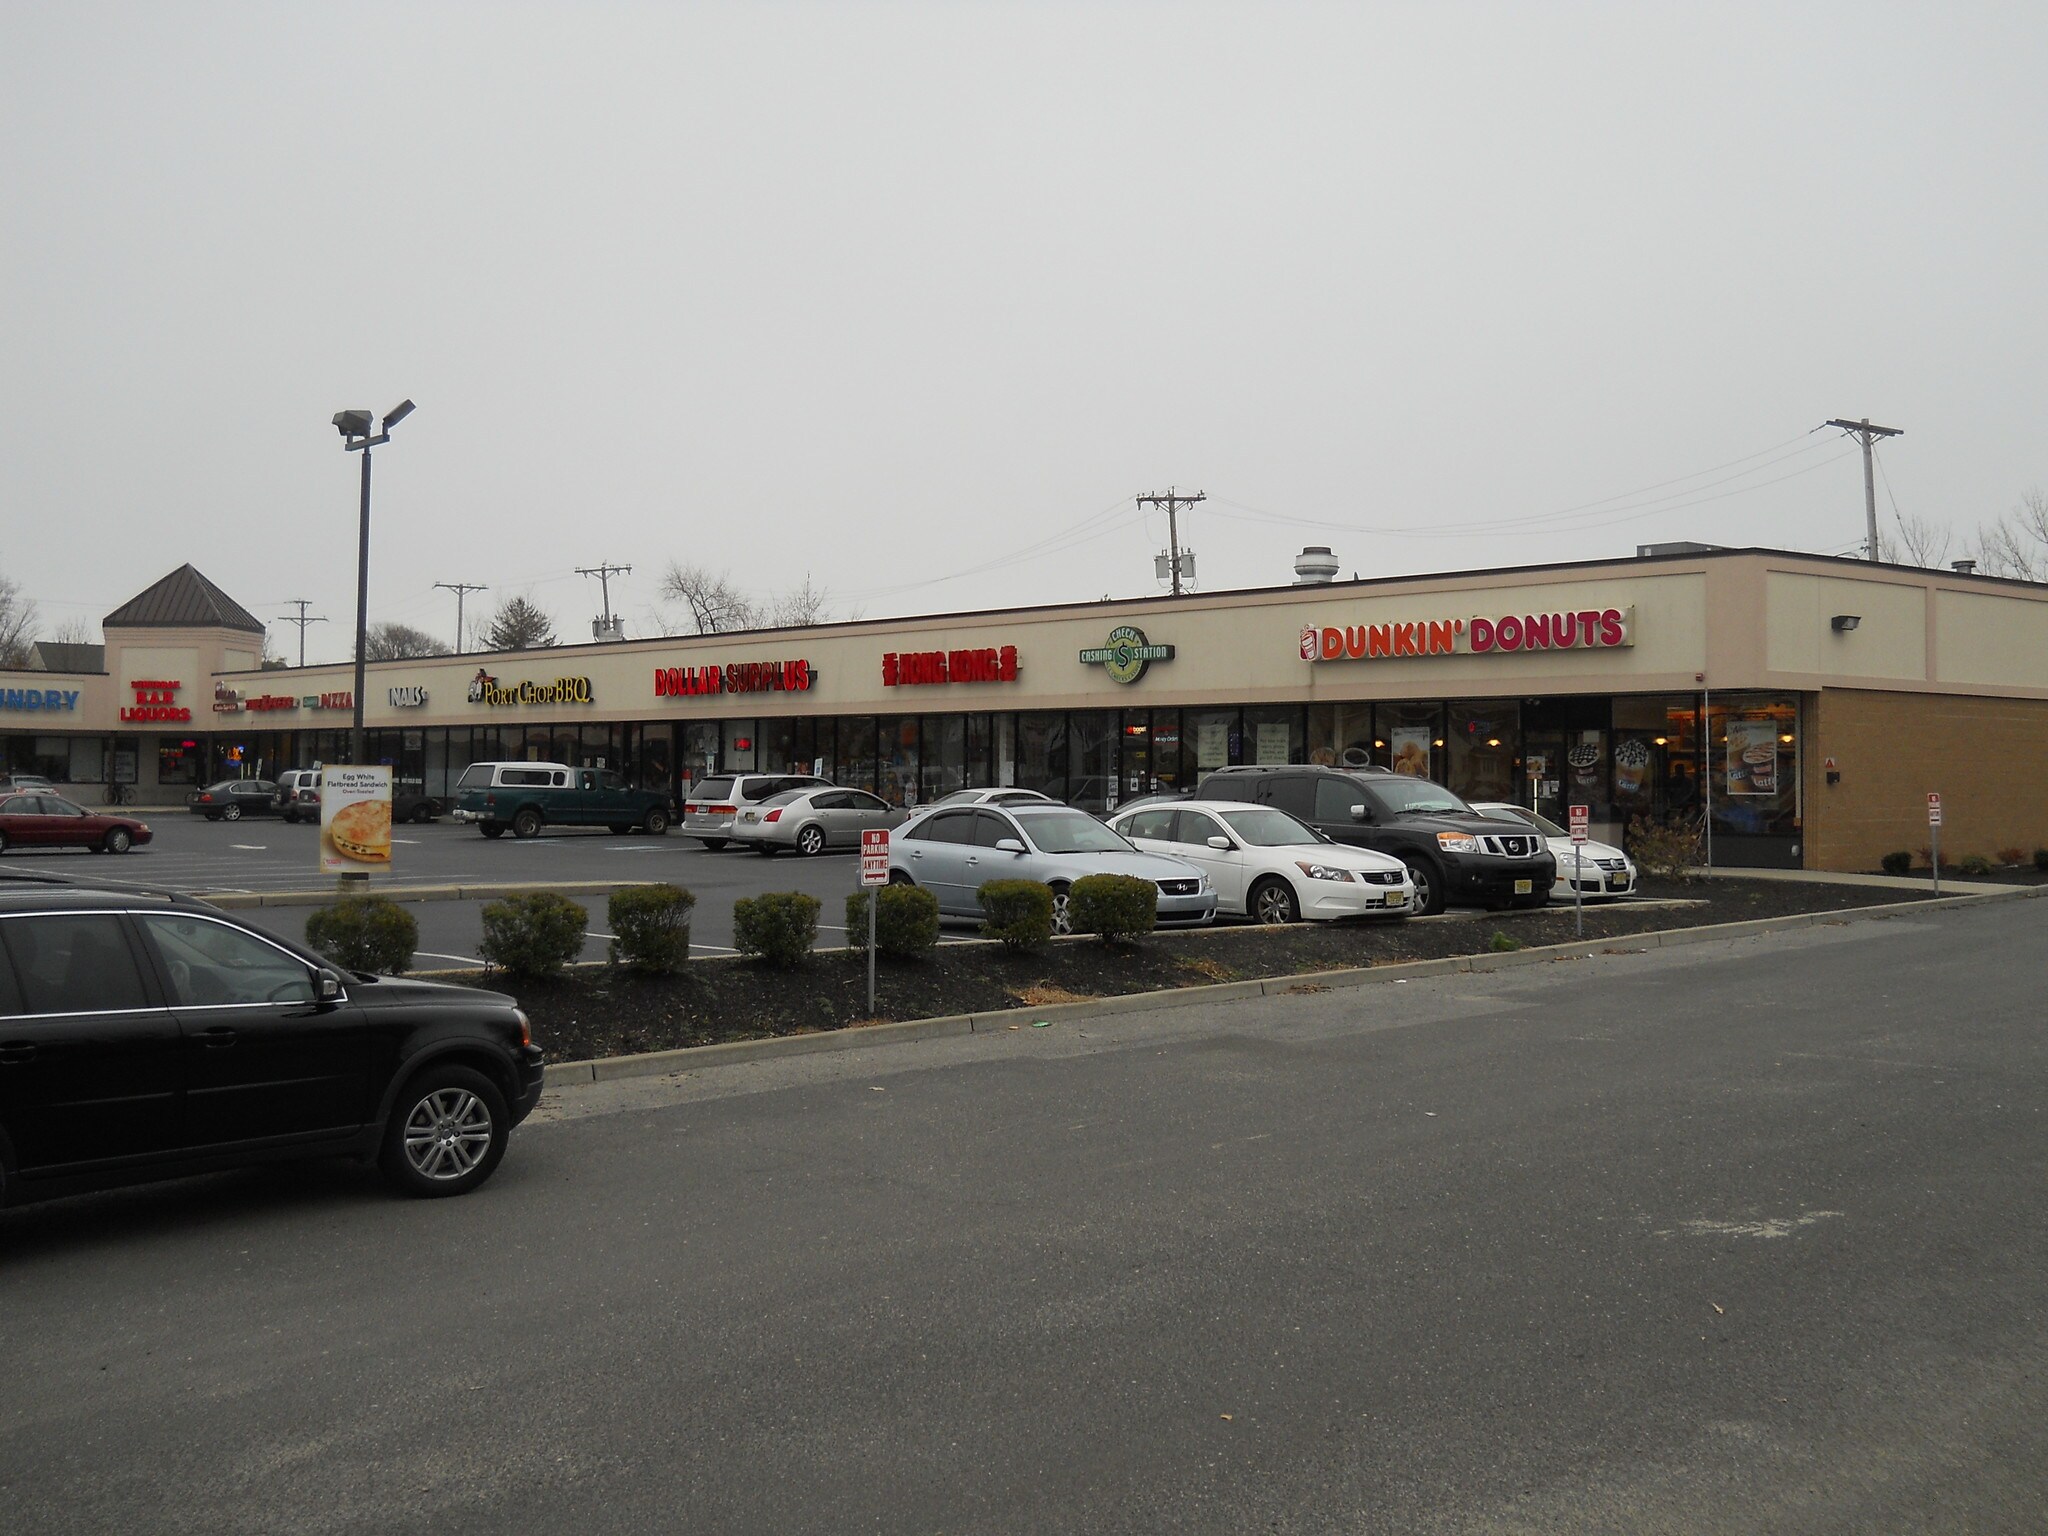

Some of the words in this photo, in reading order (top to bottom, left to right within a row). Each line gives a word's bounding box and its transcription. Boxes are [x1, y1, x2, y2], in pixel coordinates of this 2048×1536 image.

[1111, 627, 1135, 641] CHECK
[1322, 619, 1463, 660] DUNKIN'
[1470, 609, 1623, 652] DONUTS
[1081, 649, 1113, 662] CASHING
[1134, 646, 1167, 659] STATION
[899, 651, 947, 685] HONG
[948, 648, 999, 682] KONG
[655, 665, 722, 696] DOLLAR
[726, 659, 810, 693] SURPLUS
[554, 677, 591, 703] BBQ
[136, 691, 175, 705] BAR
[120, 707, 192, 722] LIQUORS
[871, 833, 881, 844] NO
[863, 844, 888, 855] PARKING
[864, 859, 888, 870] ANYTIME
